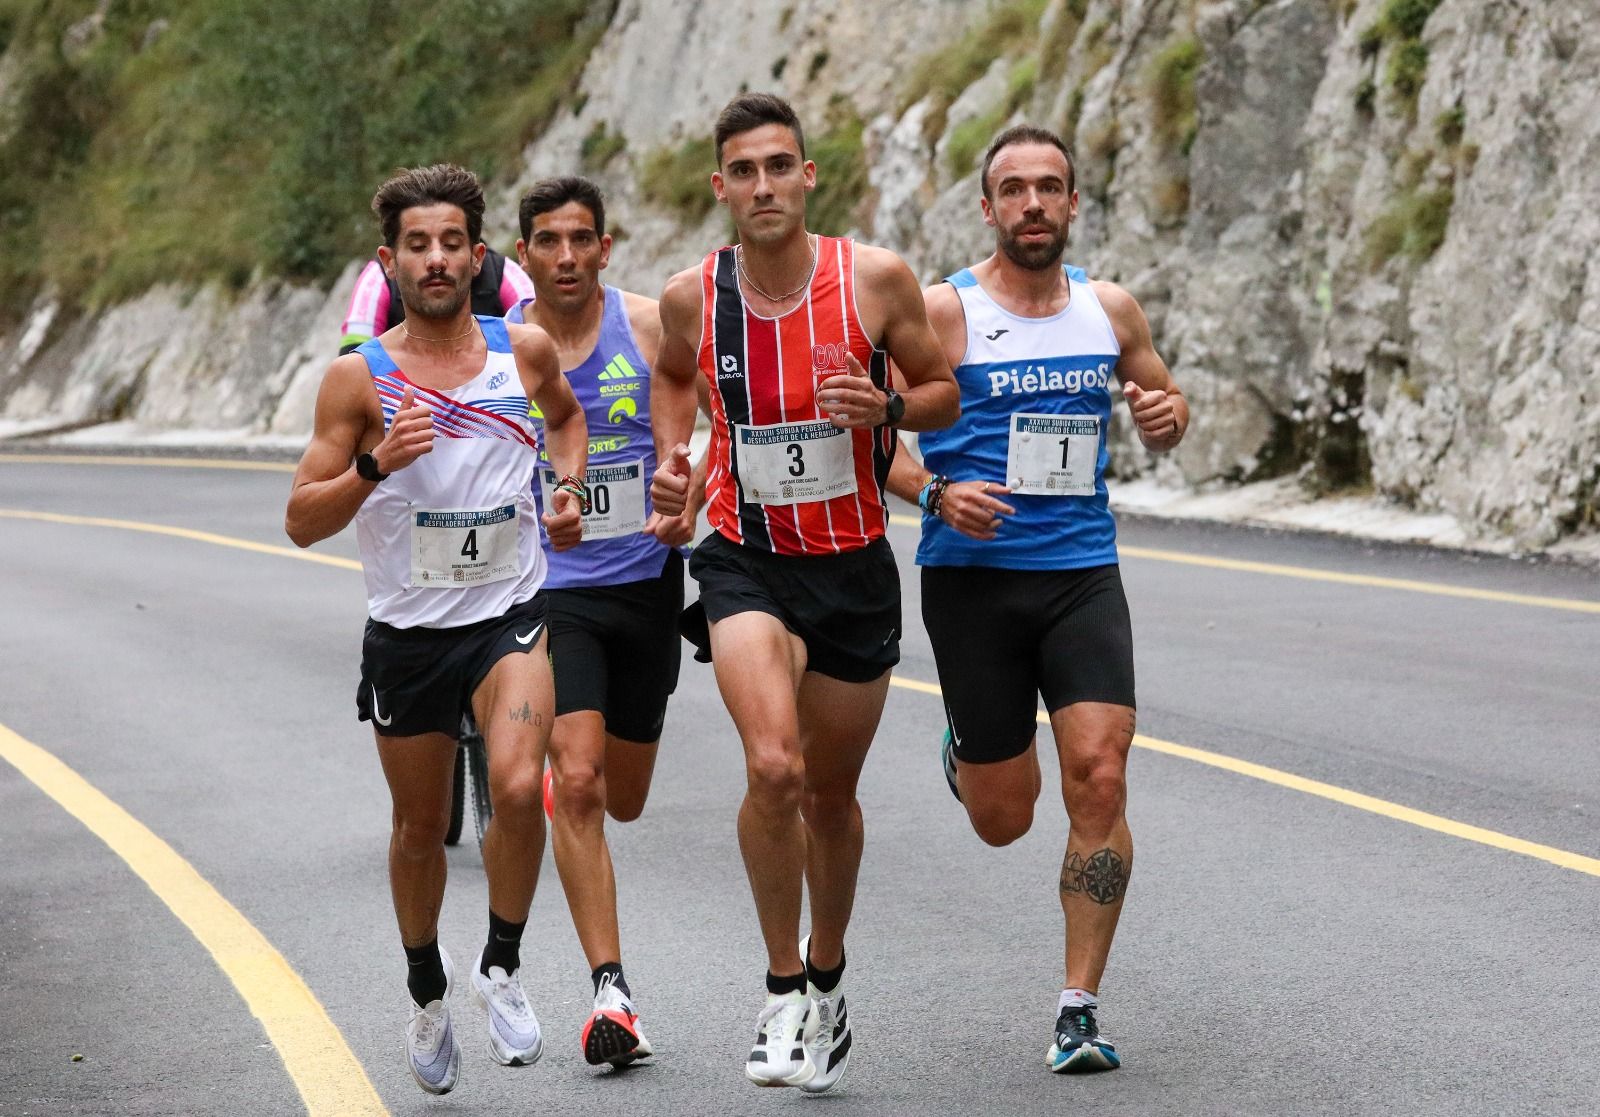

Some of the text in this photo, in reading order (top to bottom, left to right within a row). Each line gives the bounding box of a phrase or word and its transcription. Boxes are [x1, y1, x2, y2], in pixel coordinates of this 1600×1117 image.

[751, 422, 834, 438] XXXVIII SUBIDA PEDESTRE
[1023, 424, 1062, 434] DESFILADERO
[1063, 426, 1070, 434] DE
[1052, 419, 1072, 427] SUBIDA
[1072, 420, 1095, 428] PEDESTRE
[747, 428, 839, 445] DESFILADERO DE LA HERMIDA
[786, 443, 805, 477] 3
[1059, 437, 1069, 469] 1
[598, 474, 607, 482] LA
[607, 472, 633, 482] HERMIDA
[599, 466, 628, 476] PEDESTRE
[423, 513, 510, 528] DESFILADERO DE LA HERMIDA
[428, 507, 506, 521] XXXVIII SUBIDA PEDESTRE
[461, 529, 479, 561] 4
